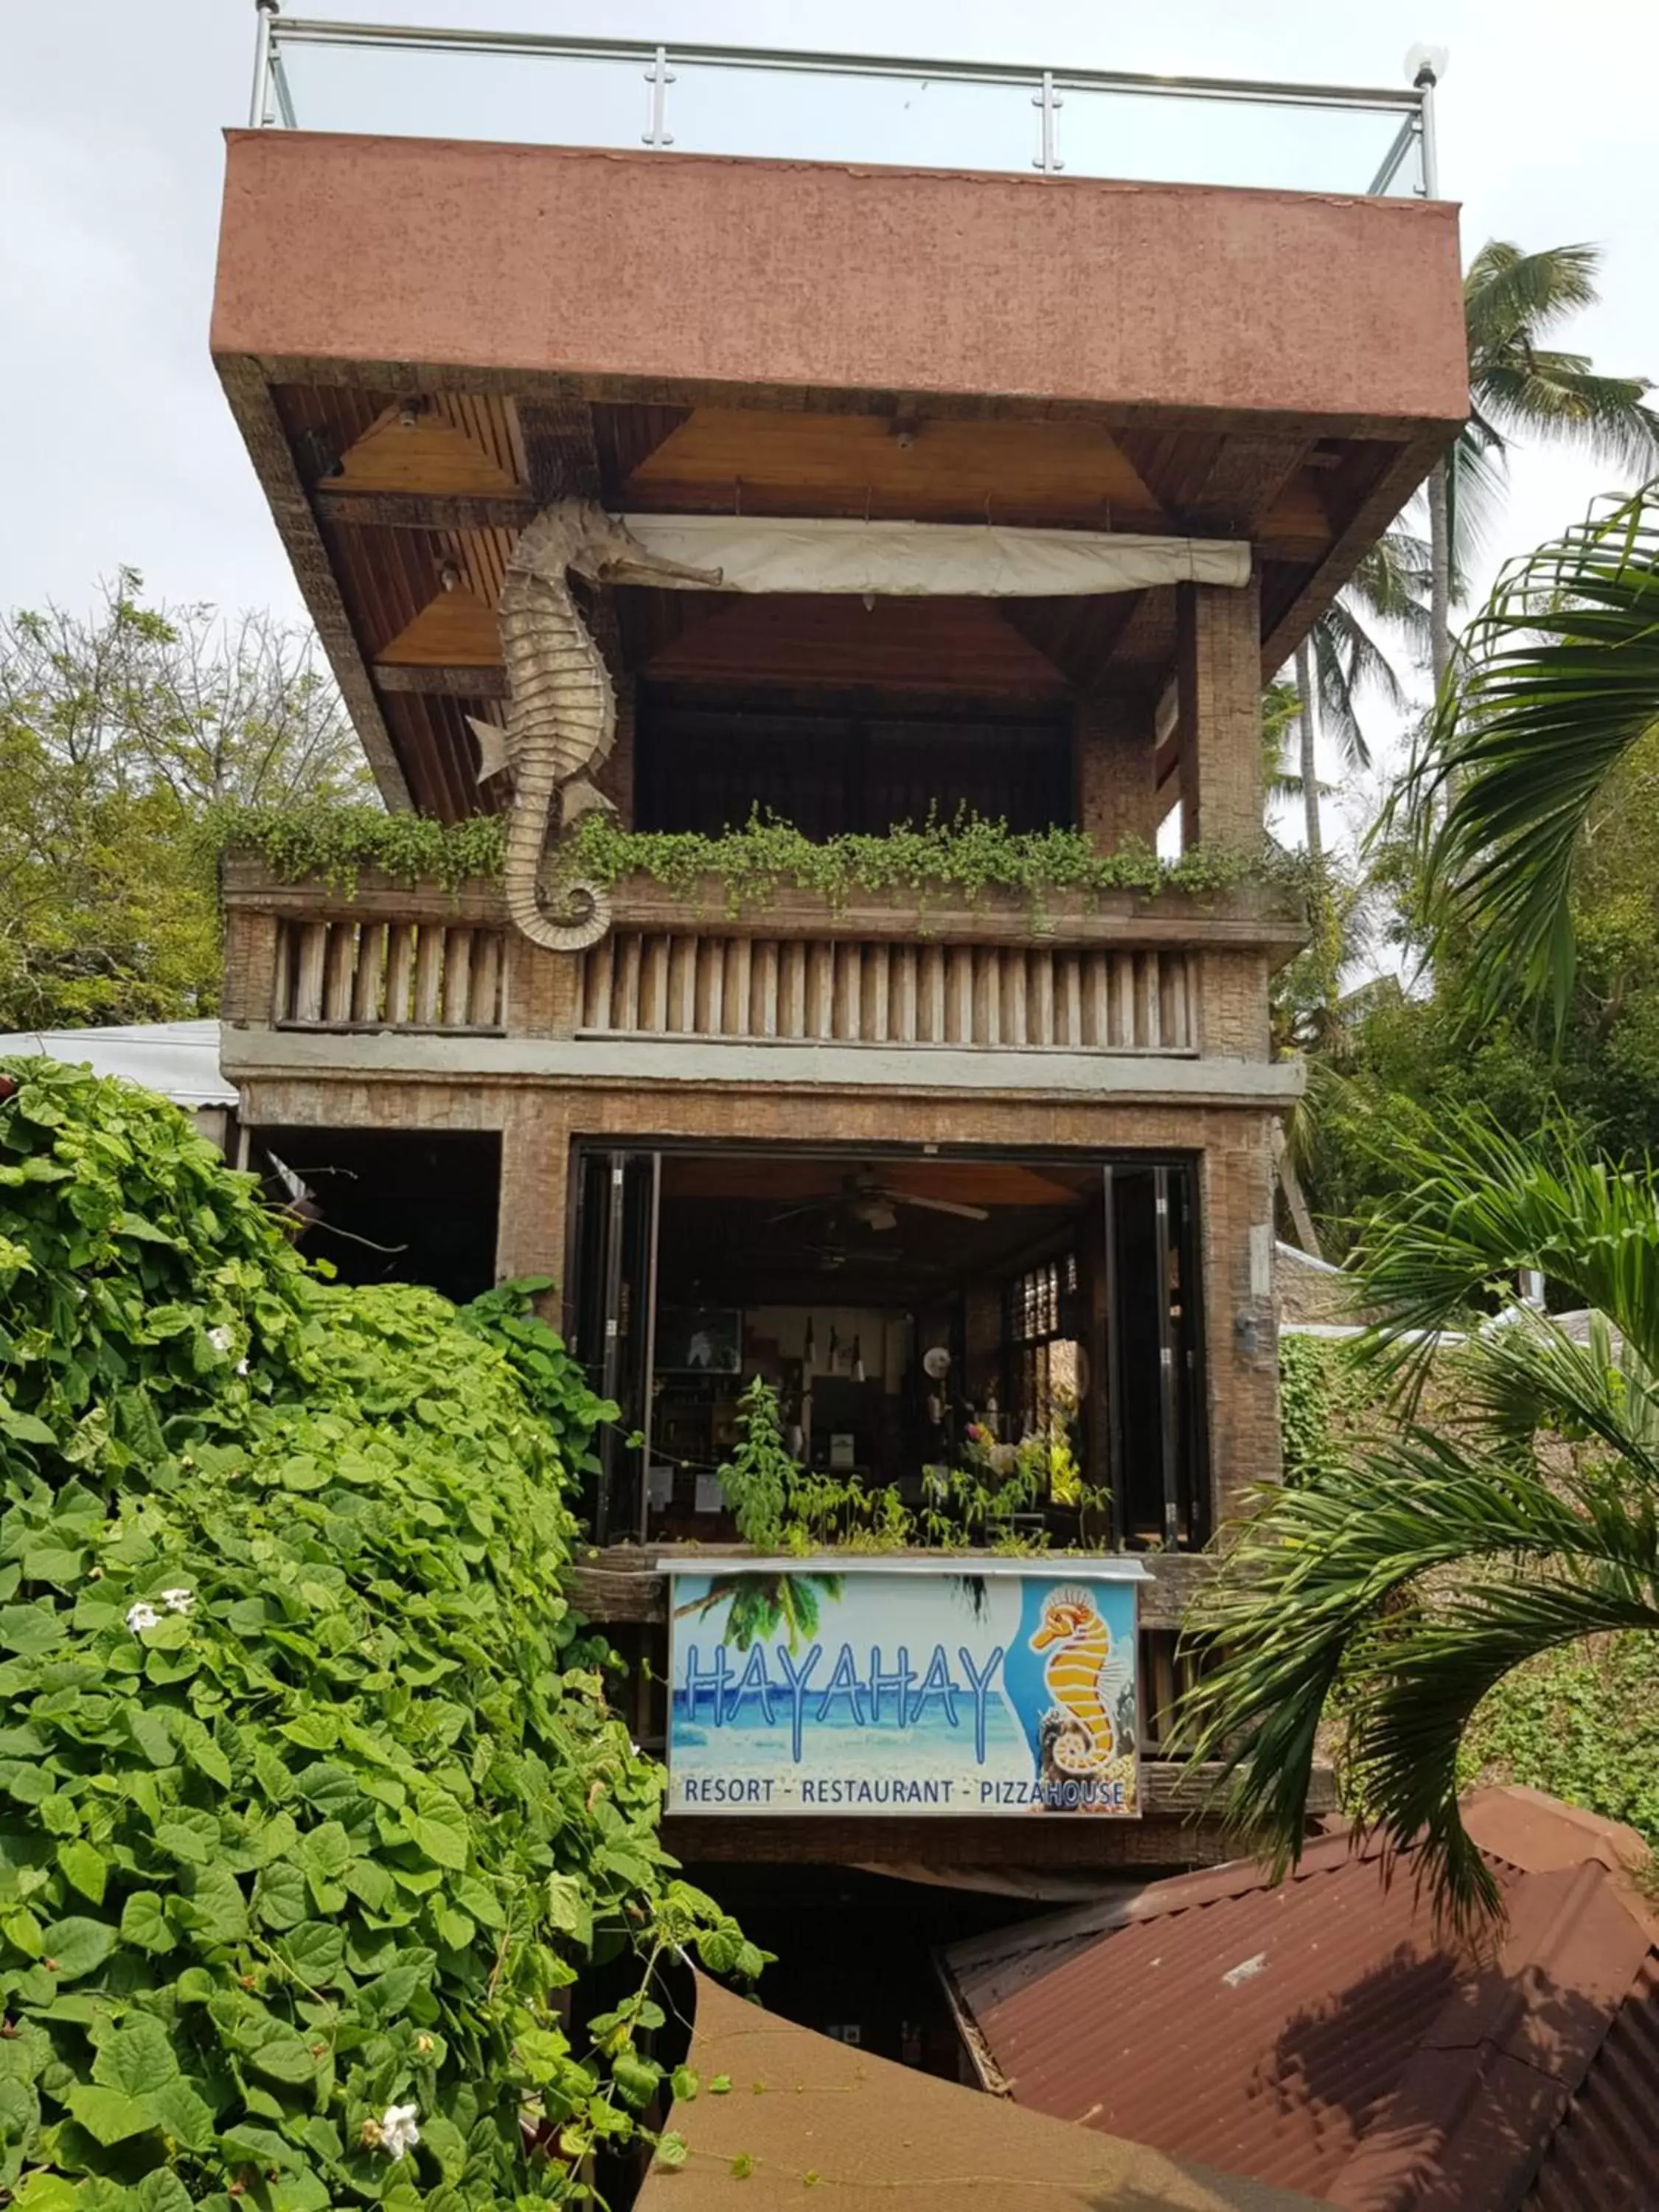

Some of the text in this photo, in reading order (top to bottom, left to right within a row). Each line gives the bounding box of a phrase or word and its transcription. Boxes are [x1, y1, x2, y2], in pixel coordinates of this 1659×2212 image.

[686, 1643, 1004, 1764] HAYAHAY
[685, 1778, 775, 1802] RESORT
[801, 1779, 953, 1804] RESTAURANT
